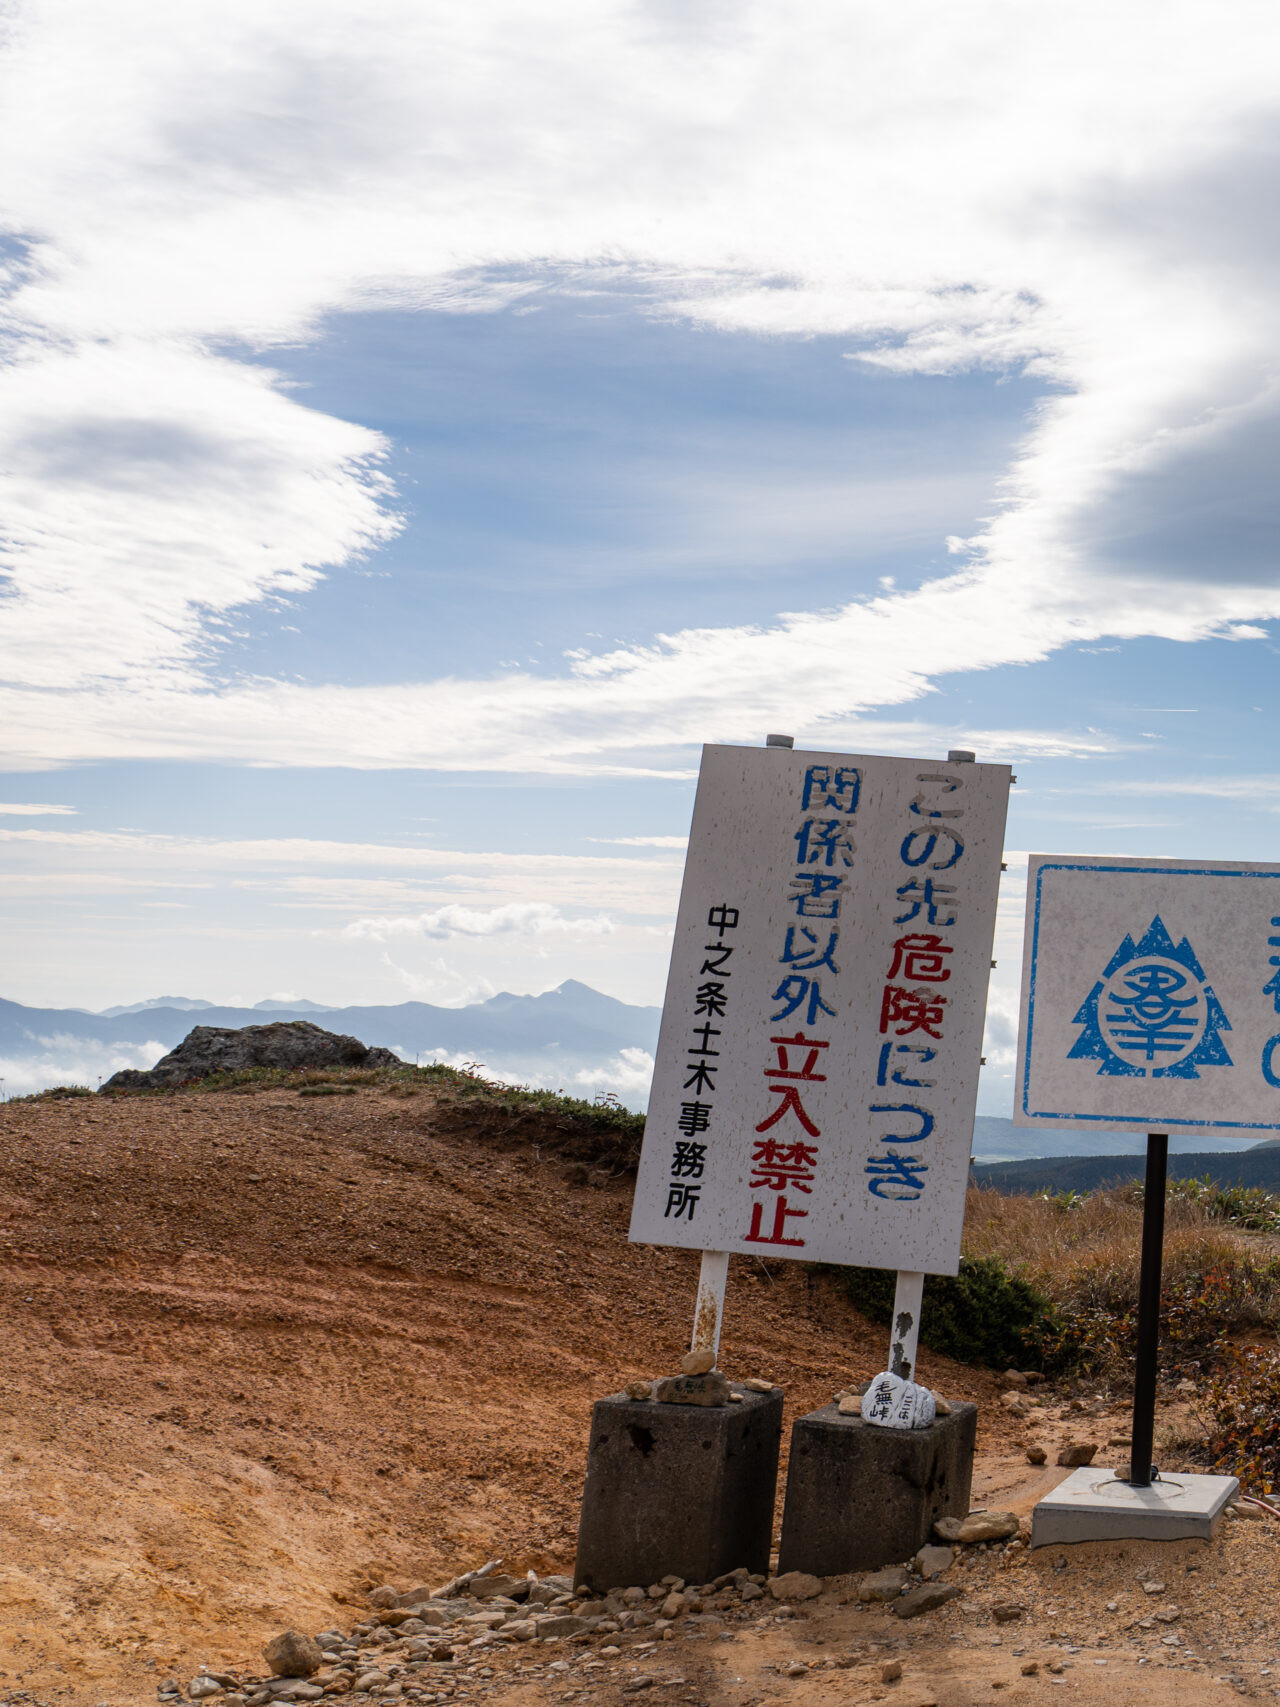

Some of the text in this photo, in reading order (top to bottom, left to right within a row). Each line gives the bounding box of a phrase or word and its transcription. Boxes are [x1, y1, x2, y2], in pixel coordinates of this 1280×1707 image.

[664, 903, 739, 1221] 中之条土木事務所
[743, 764, 863, 1248] 関係者以外立入禁止
[862, 772, 965, 1202] この先危険につき
[869, 1380, 897, 1421] 毛無峠
